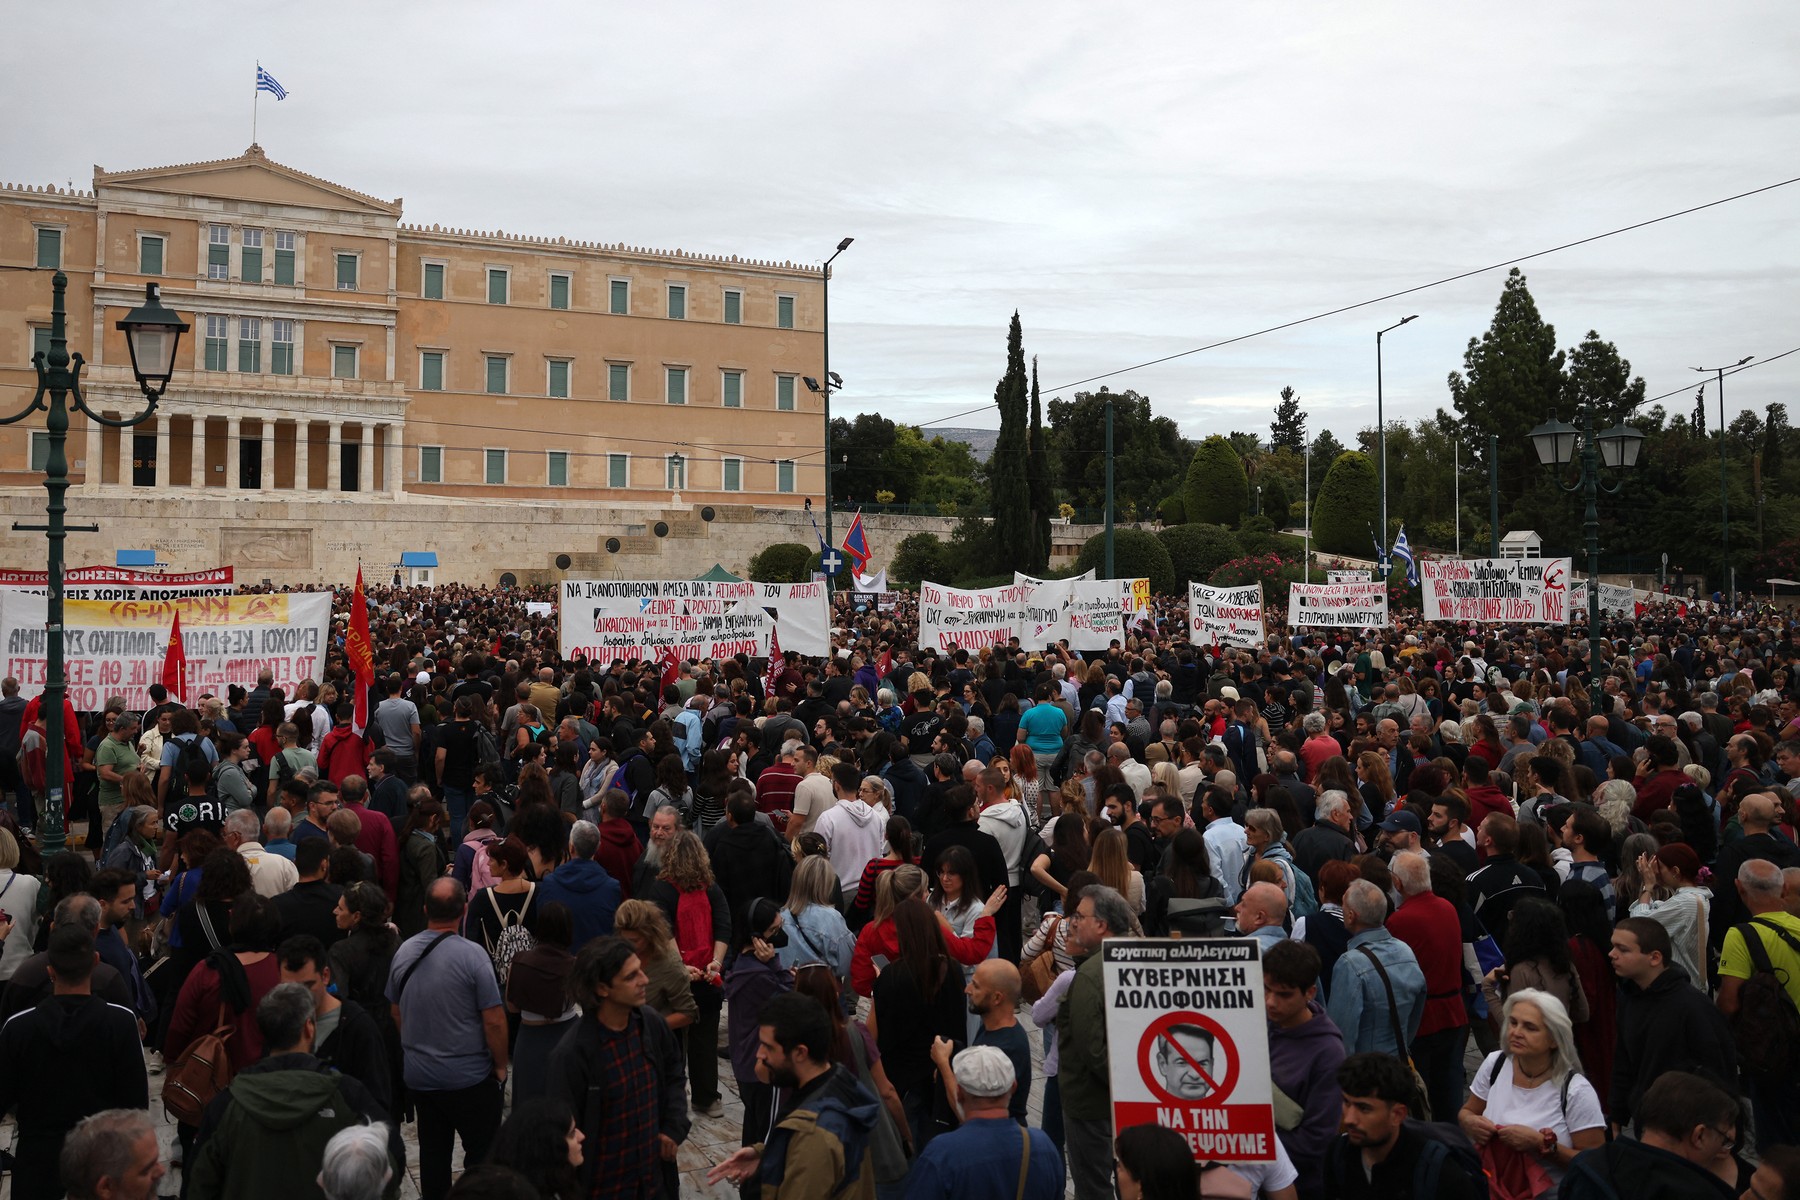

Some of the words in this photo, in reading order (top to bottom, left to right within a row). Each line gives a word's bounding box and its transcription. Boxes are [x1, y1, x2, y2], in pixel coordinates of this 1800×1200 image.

[133, 570, 226, 583] ΣΚΟΤΩΝΟΥΝ
[94, 589, 136, 601] ΧΩΡΙΣ
[140, 588, 232, 601] ΑΠΟΖΗΜΙΩΣΗ
[567, 583, 582, 598] ΝΑ
[585, 582, 659, 599] ΙΚΑΝΟΠΟΙΗΘΟΥΝ
[662, 582, 689, 597] ΑΜΕΣΑ
[691, 582, 706, 597] ΟΛΑ
[716, 583, 755, 599] ΑΙΤΗΜΑΤΑ
[764, 585, 780, 597] ΤΟΥ
[925, 586, 940, 605] ΣΤΟ
[978, 594, 994, 609] ΤΟΥ
[1542, 591, 1564, 621] ΟΚΔΕ
[595, 616, 645, 633] ΔΙΚΑΙΟΣΥΝΗ
[670, 615, 698, 630] ΤΕΜΠΗ
[725, 613, 763, 630] ΣΥΓΚΑΛΥΨΗ
[926, 607, 942, 625] ΟΧΙ
[1298, 611, 1335, 624] ΕΠΙΤΡΟΠΗ
[1336, 611, 1384, 625] ΑΛΛΗΛΕΓΓΥΗΣ
[711, 640, 758, 659] ΑΘΗΝΑΣ
[1117, 967, 1247, 988] ΚΥΒΕΡΝΗΣΗ
[1113, 989, 1255, 1010] ΔΟΛΟΦΟΝΩΝ
[1156, 1107, 1186, 1130] ΝΑ
[1189, 1108, 1229, 1131] ΤΗΝ
